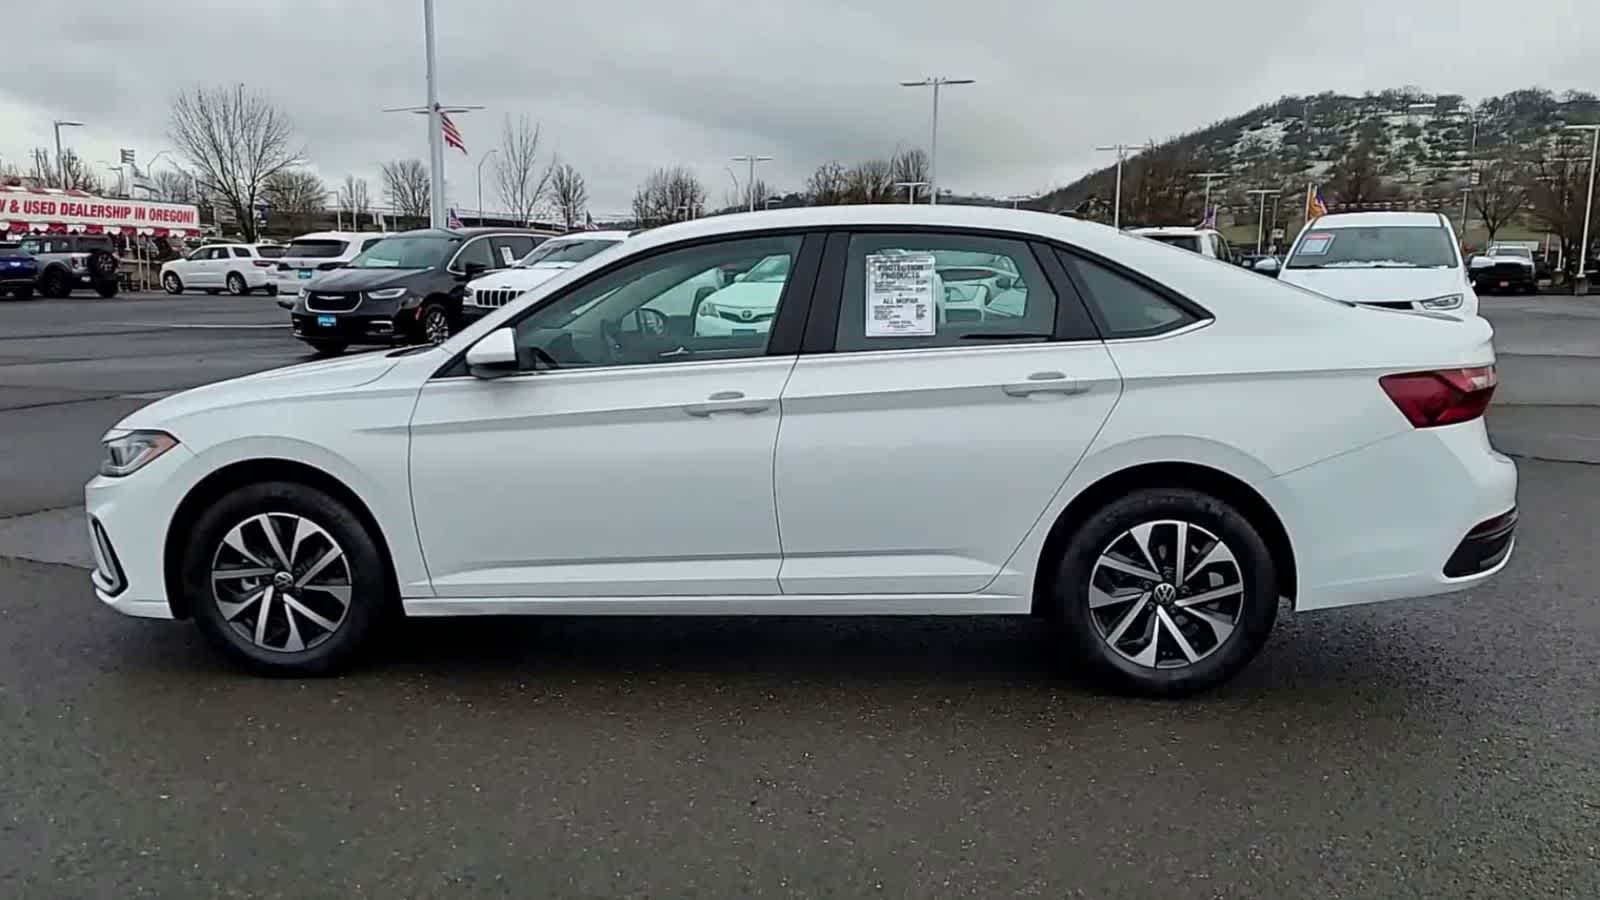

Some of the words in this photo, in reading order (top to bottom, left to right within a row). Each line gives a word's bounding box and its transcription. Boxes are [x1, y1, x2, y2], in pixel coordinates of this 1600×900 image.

[9, 200, 19, 213] &
[23, 201, 56, 215] USED
[60, 203, 131, 219] DEALERSHIP
[134, 207, 146, 220] IN
[150, 208, 194, 223] OREGON!
